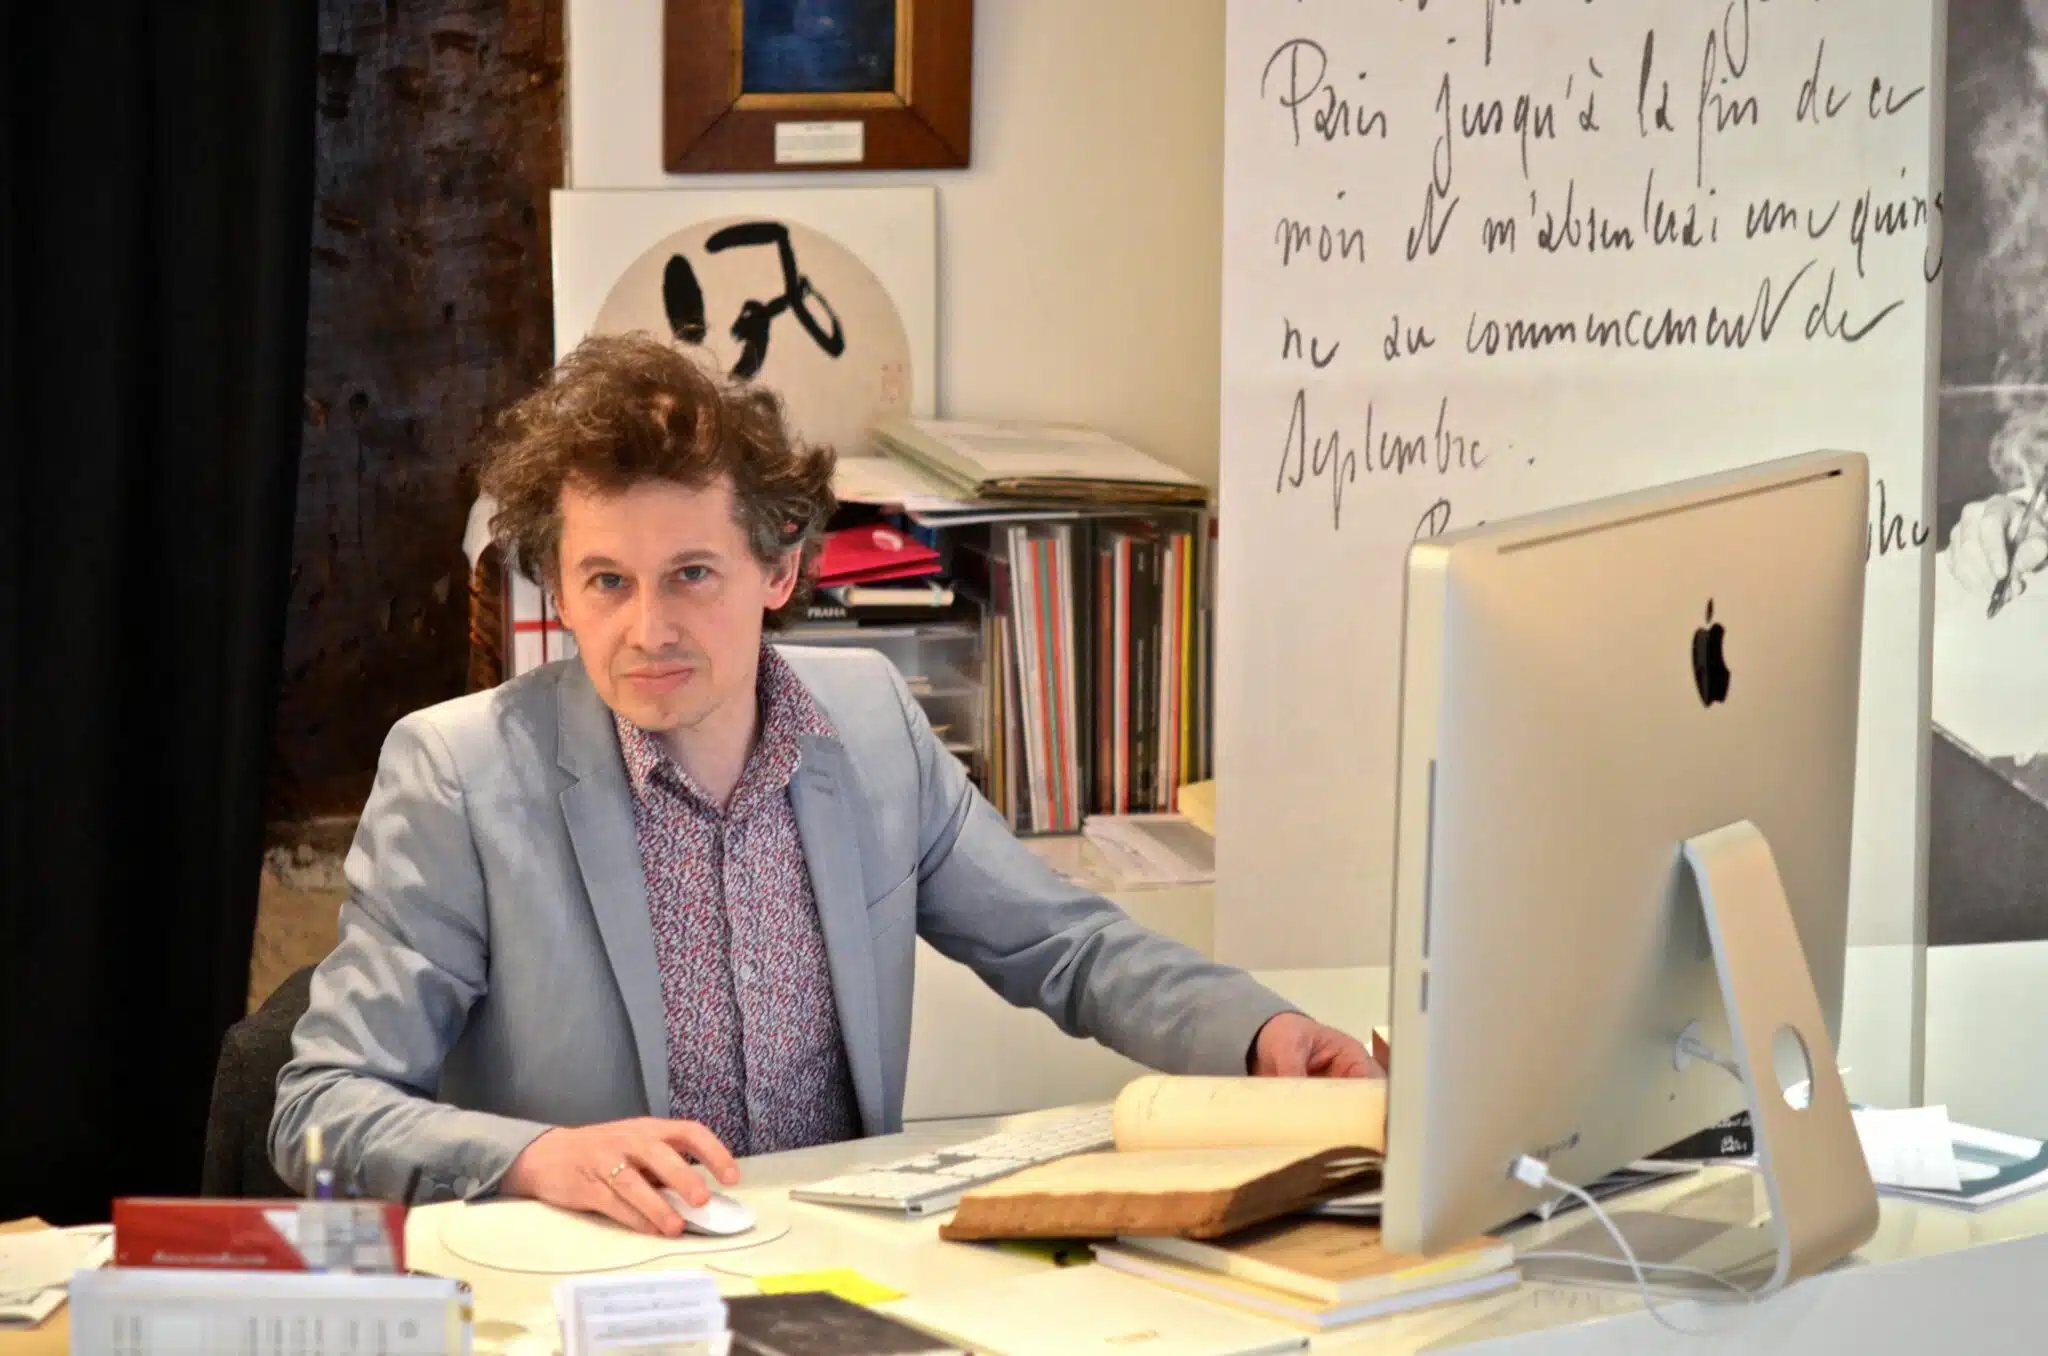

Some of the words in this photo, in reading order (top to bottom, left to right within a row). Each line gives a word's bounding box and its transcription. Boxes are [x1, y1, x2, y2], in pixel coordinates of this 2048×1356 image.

[1260, 37, 1388, 148] Paris
[1432, 45, 1604, 199] jusqu'à
[1637, 28, 1675, 138] la
[1696, 28, 1759, 189] fin
[1796, 38, 1852, 125] de
[1745, 198, 1841, 241] une
[1804, 267, 1905, 344] de
